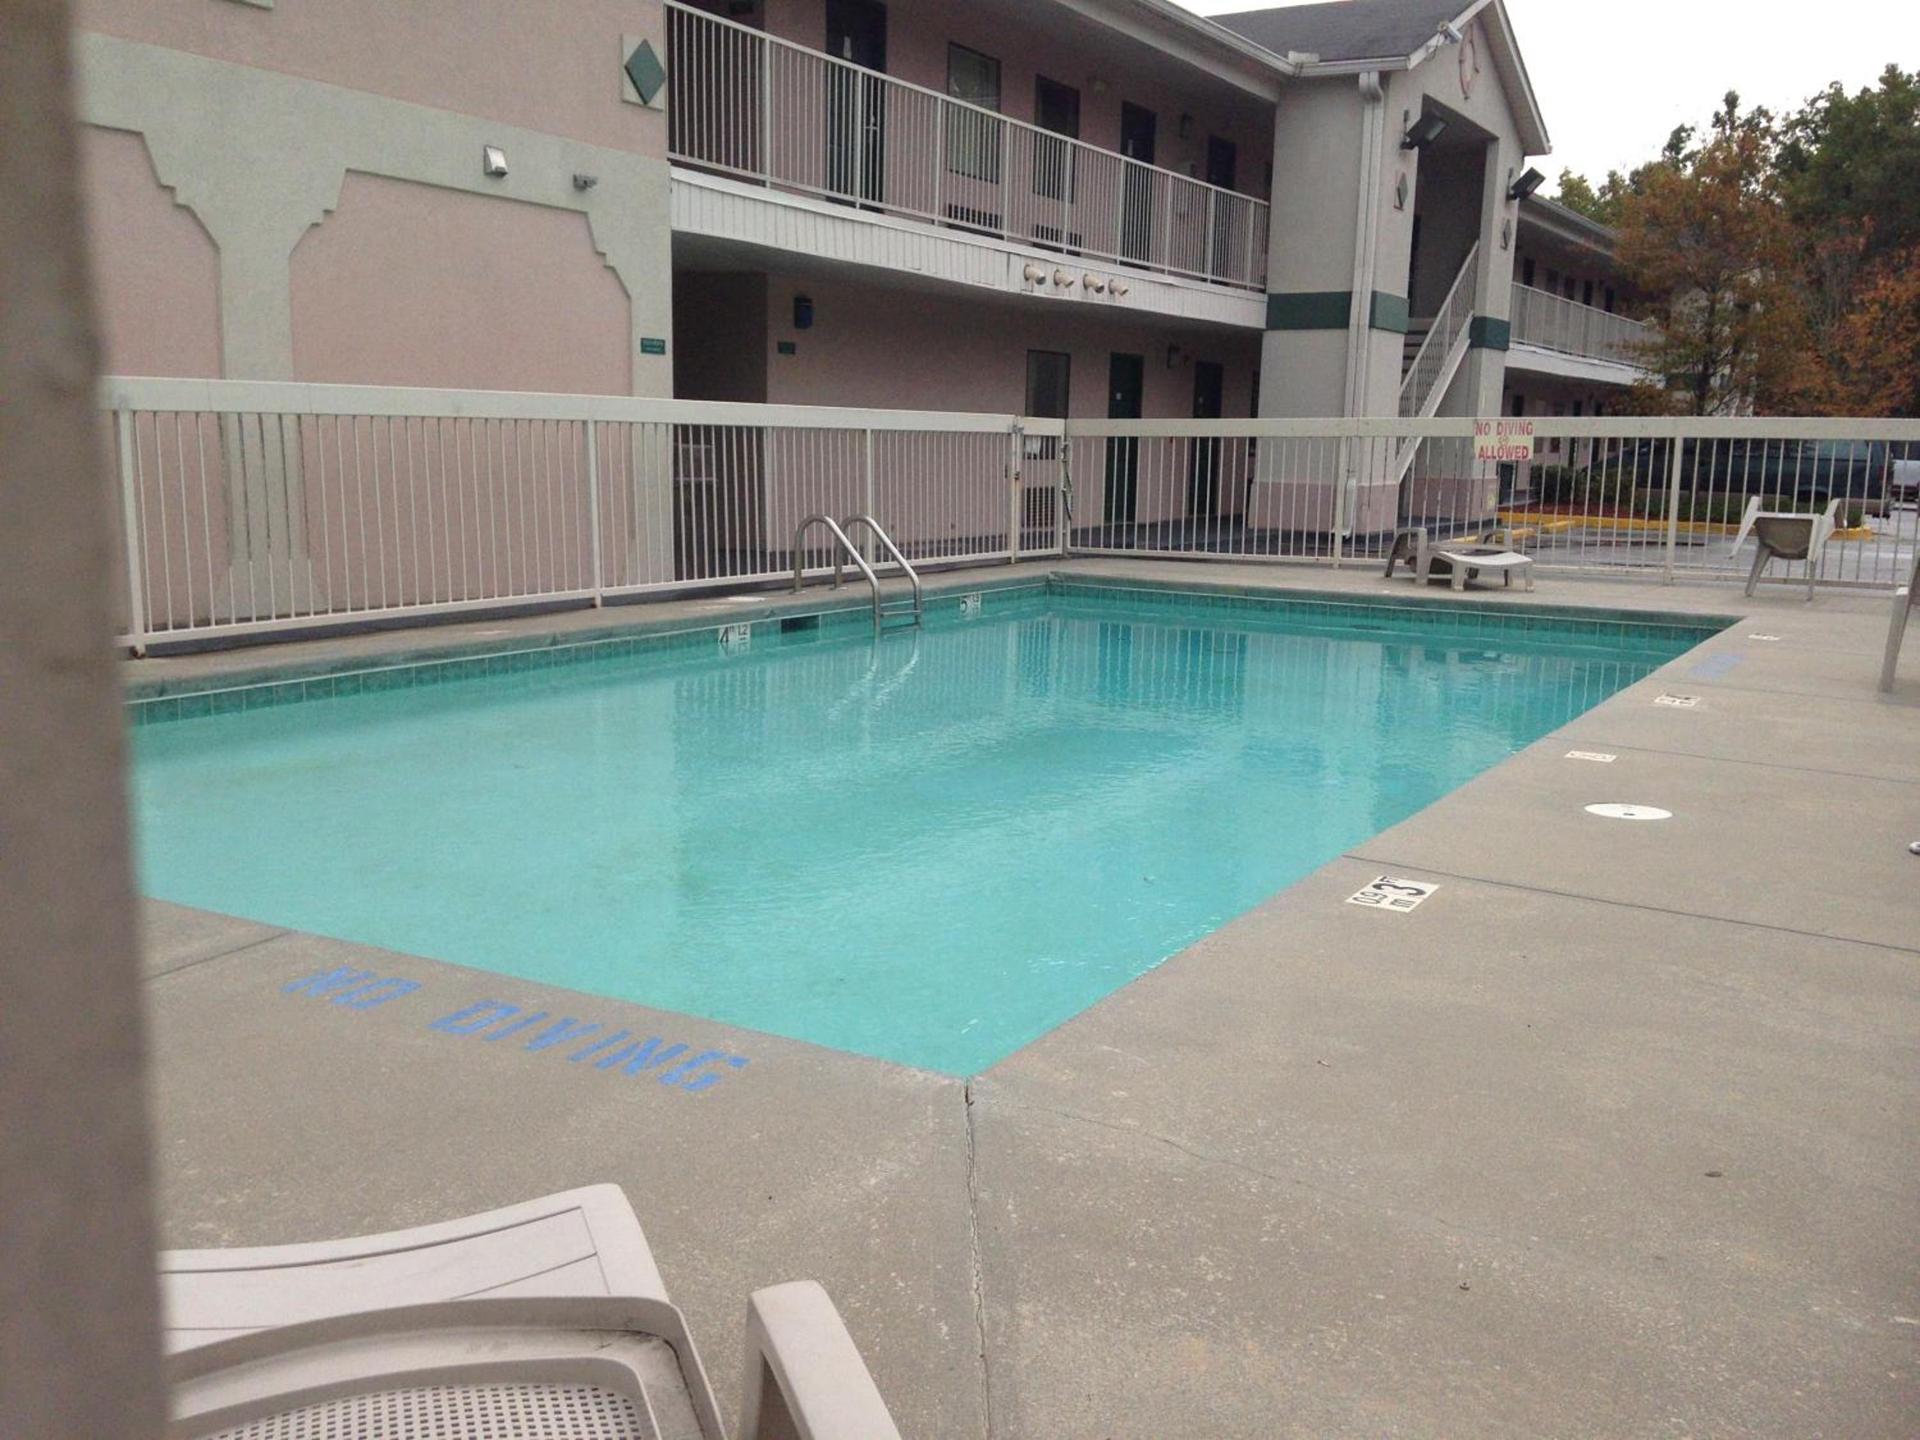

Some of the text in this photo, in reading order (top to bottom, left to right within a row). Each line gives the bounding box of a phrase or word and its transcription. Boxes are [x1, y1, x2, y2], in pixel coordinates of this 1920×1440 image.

[1475, 422, 1533, 437] NO DIVING
[1478, 445, 1529, 460] ALLOWED
[279, 965, 751, 1092] NO DIVING
